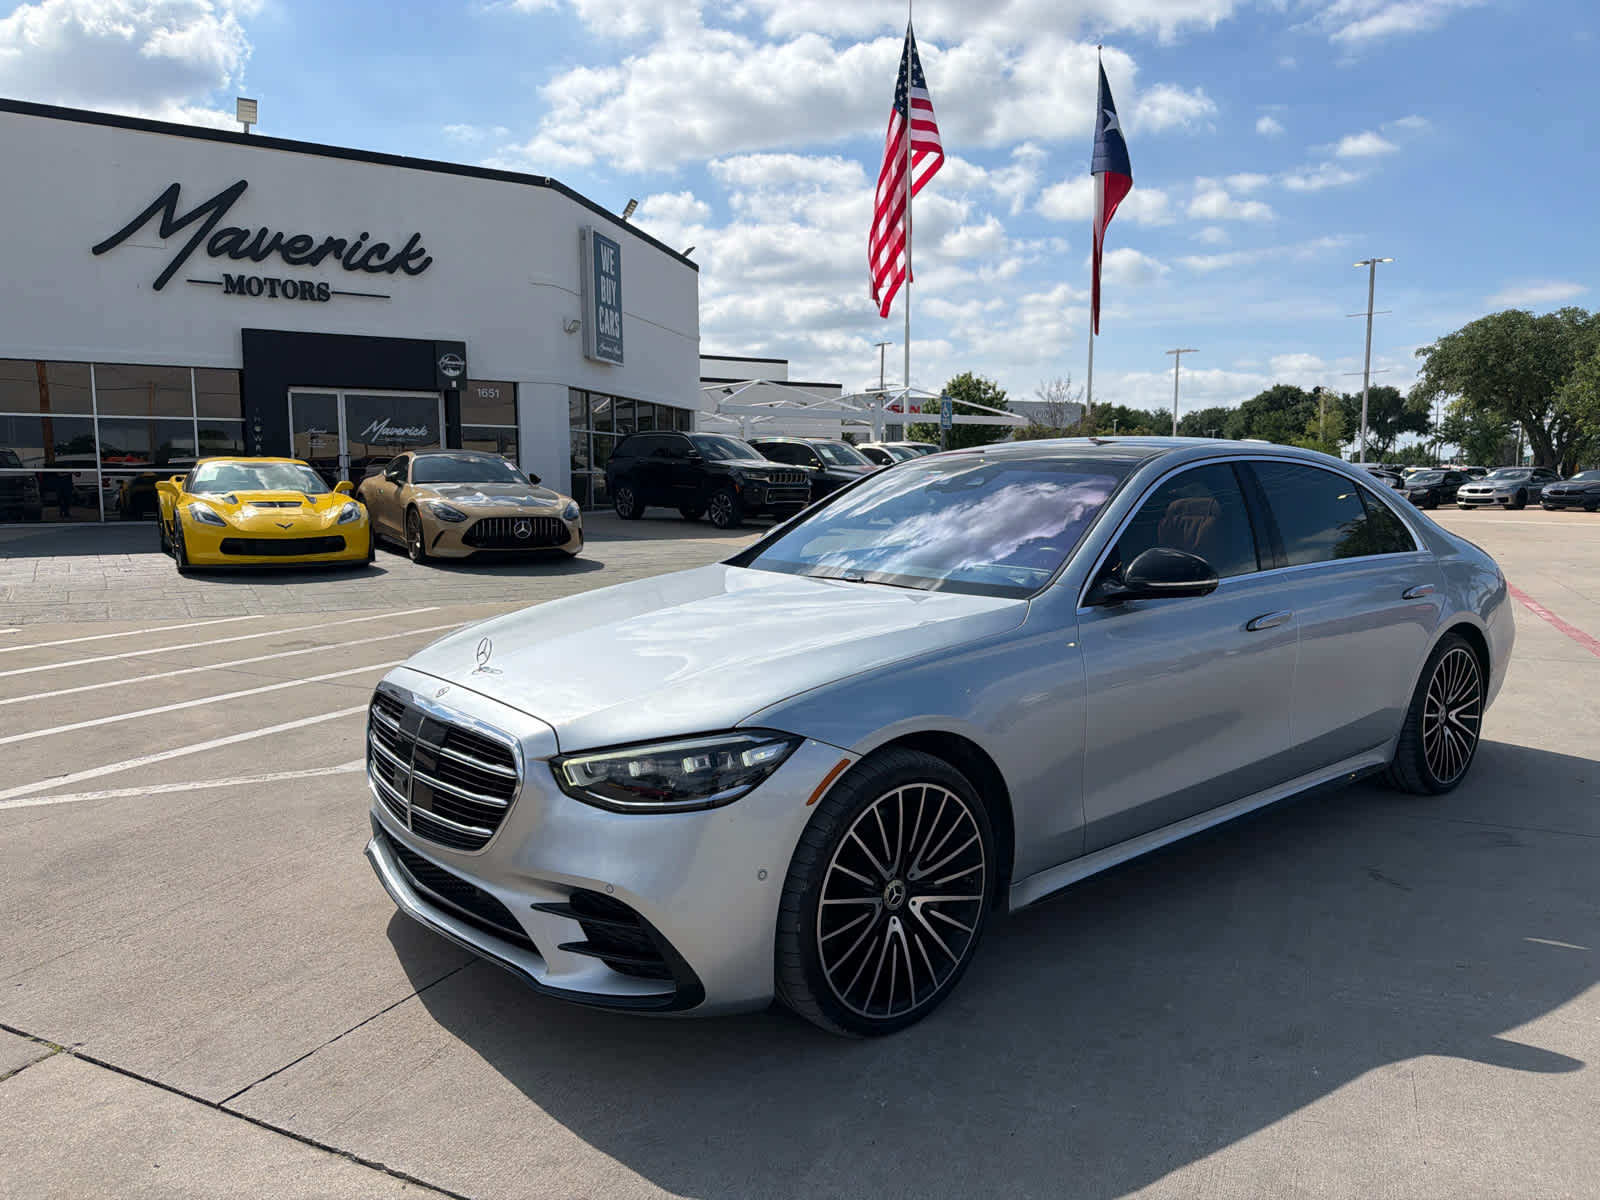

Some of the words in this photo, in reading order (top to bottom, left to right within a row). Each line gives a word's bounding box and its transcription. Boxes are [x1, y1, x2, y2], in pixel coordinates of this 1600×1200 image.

[92, 180, 433, 291] Maverick
[600, 243, 615, 275] WE
[222, 273, 331, 301] MOTORS
[600, 275, 617, 306] BUY
[599, 305, 620, 339] CARS
[477, 388, 500, 399] 1651
[361, 417, 429, 442] Maverick
